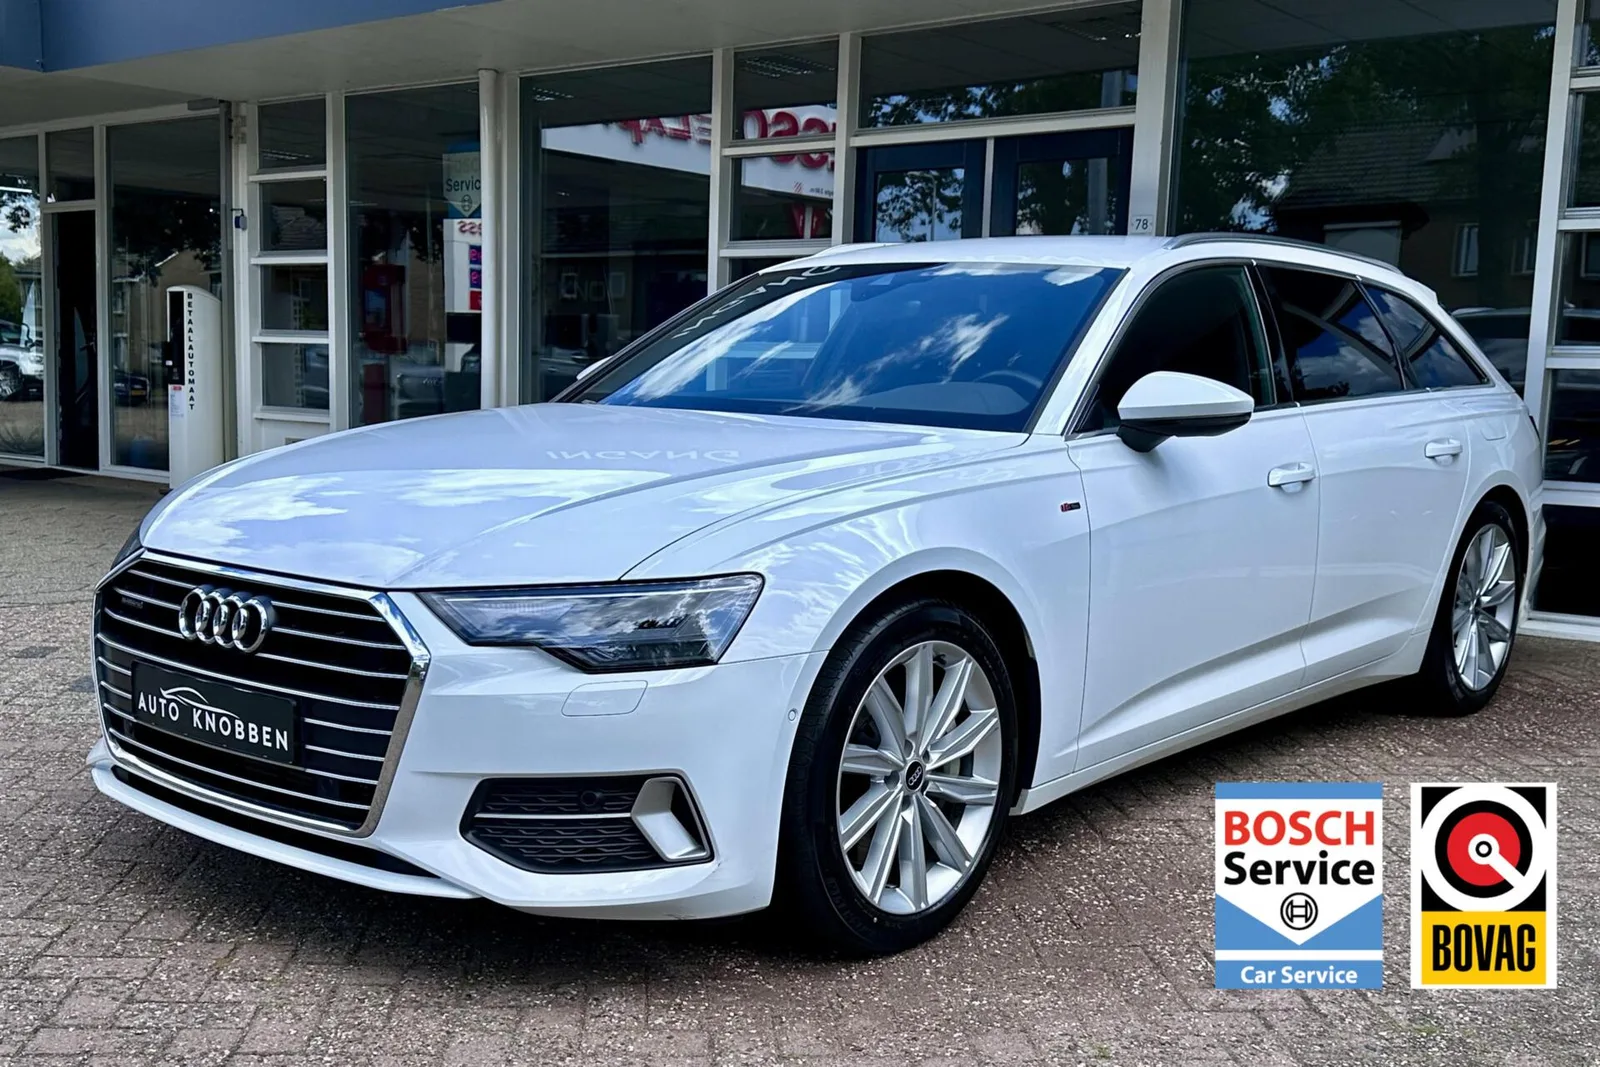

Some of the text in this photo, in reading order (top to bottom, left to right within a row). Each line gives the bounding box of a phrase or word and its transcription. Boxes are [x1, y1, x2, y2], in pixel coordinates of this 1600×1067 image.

[446, 175, 481, 192] Servic
[1135, 218, 1149, 230] 78
[187, 292, 196, 411] BETAALAUTOMAAT
[138, 691, 289, 752] AUTO KNOBBEN
